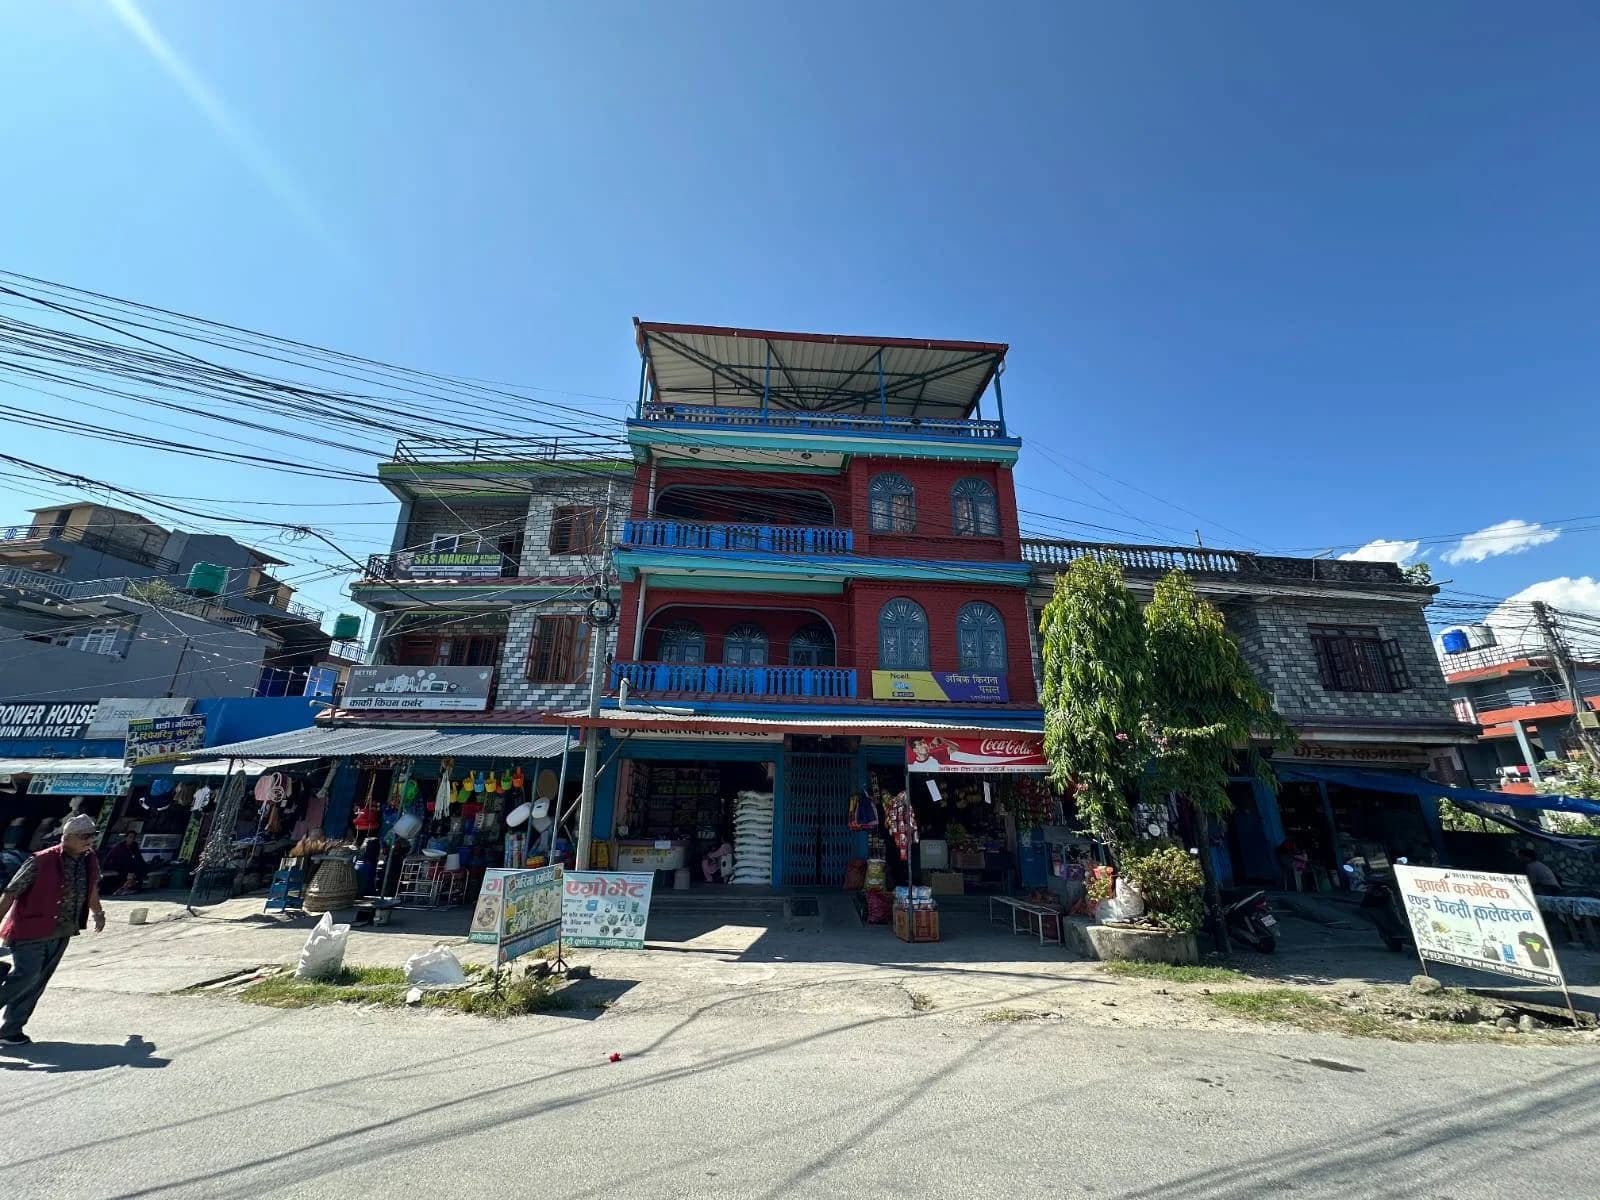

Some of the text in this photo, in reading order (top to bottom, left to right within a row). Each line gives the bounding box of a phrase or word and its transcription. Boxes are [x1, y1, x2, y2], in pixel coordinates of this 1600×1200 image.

[438, 554, 478, 564] MAKEUP
[46, 704, 98, 725] HOUSE
[24, 726, 81, 737] MARKET
[980, 737, 1031, 755] Coca-Cola
